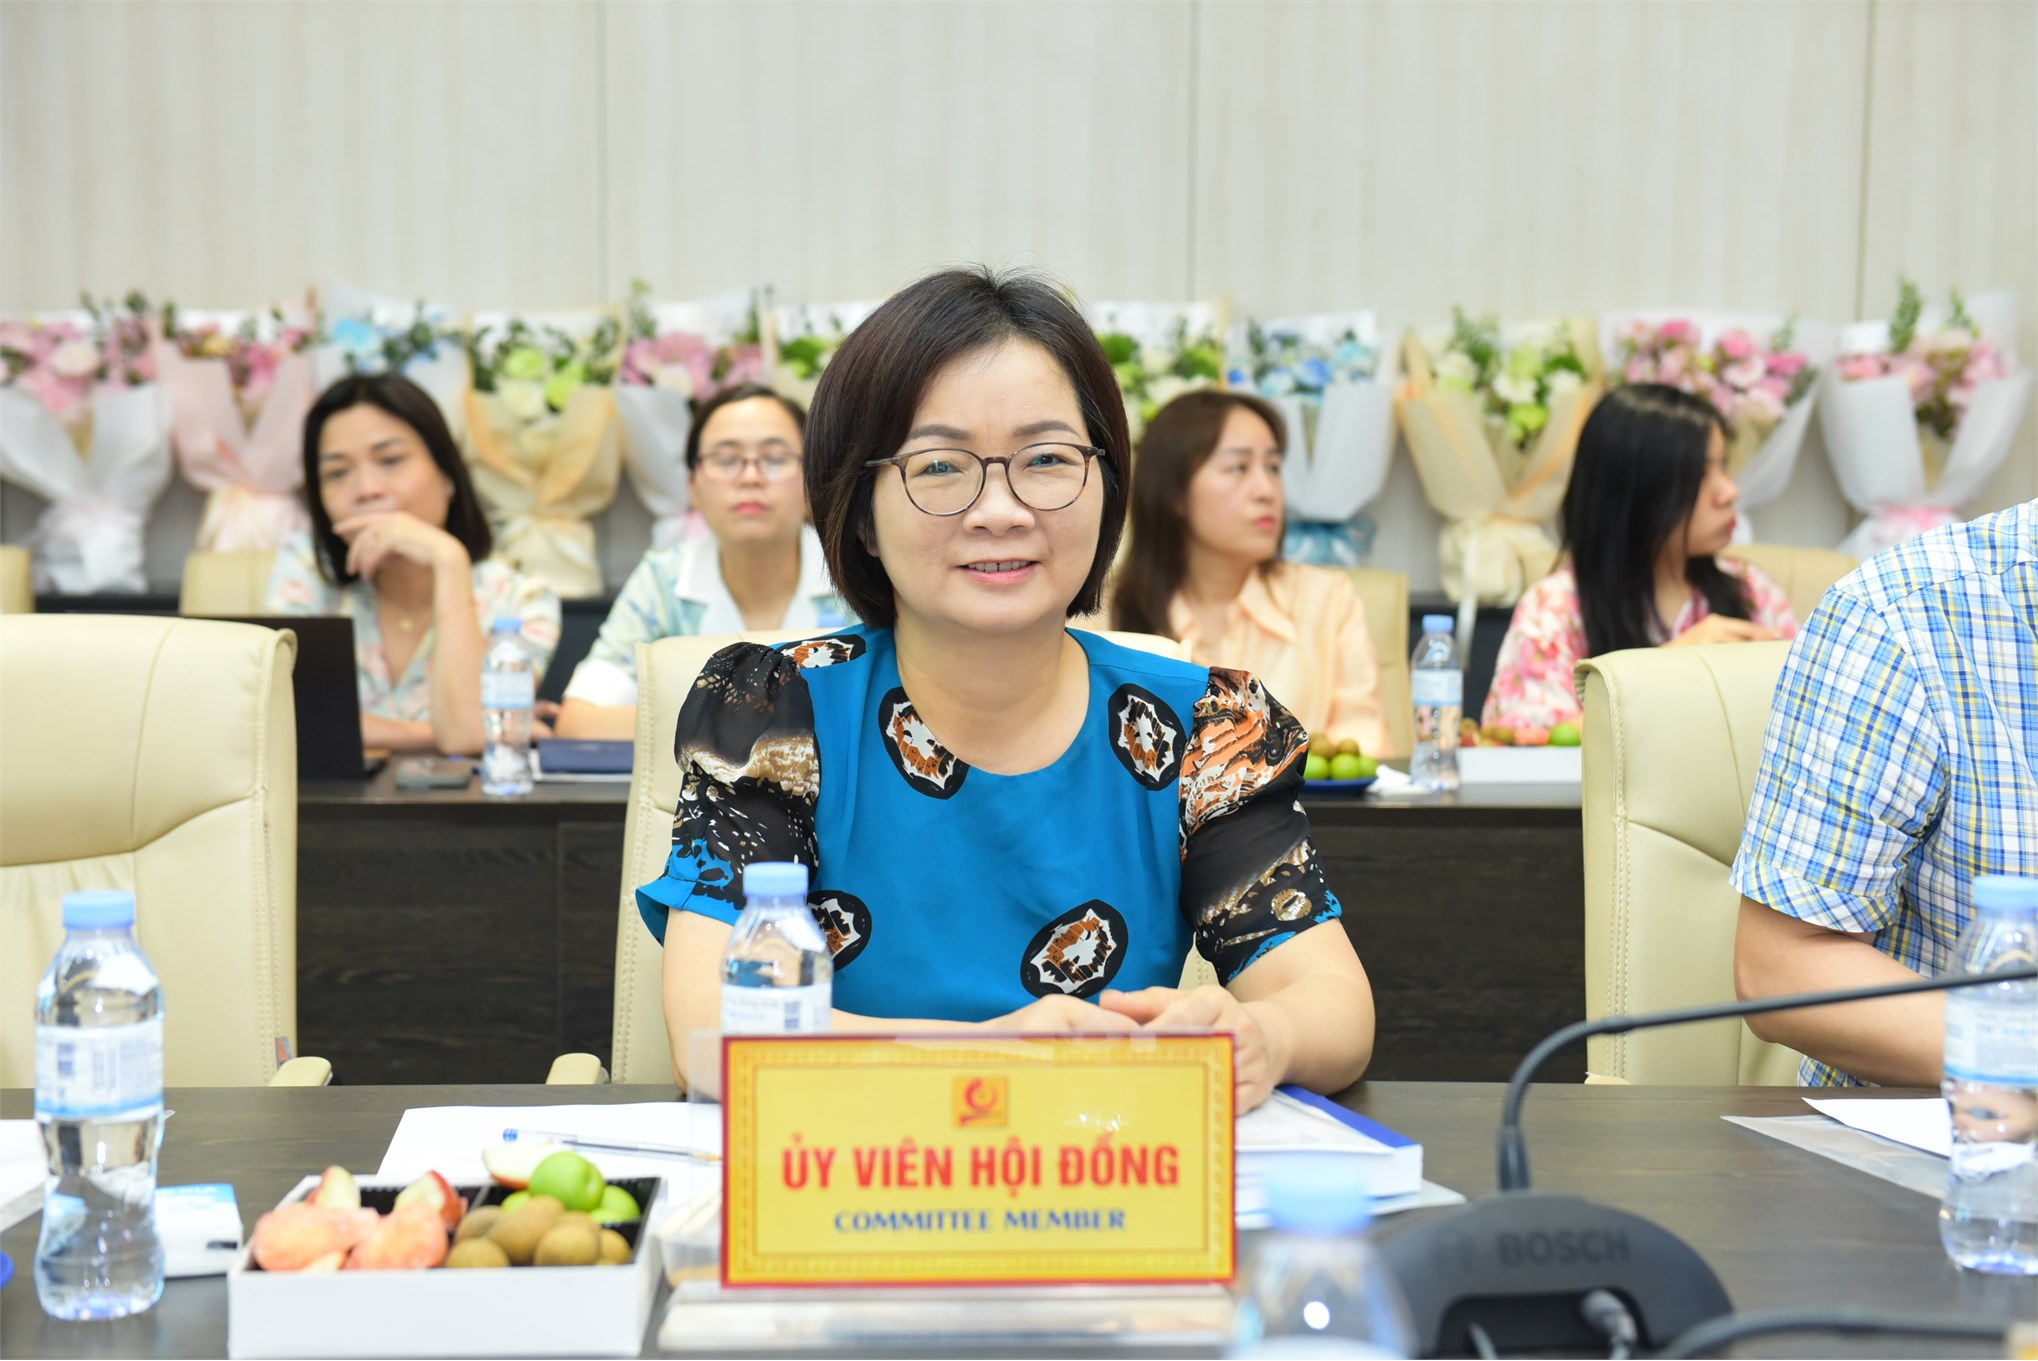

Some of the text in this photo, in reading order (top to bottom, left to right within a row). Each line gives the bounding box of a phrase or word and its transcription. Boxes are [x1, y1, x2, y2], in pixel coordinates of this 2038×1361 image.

[782, 1133, 837, 1190] ỦY
[853, 1137, 954, 1189] VIÊN
[970, 1135, 1043, 1198] HỘI
[834, 1207, 1126, 1233] COMMITTEE MEMBER
[1499, 1228, 1630, 1266] BOSCH
